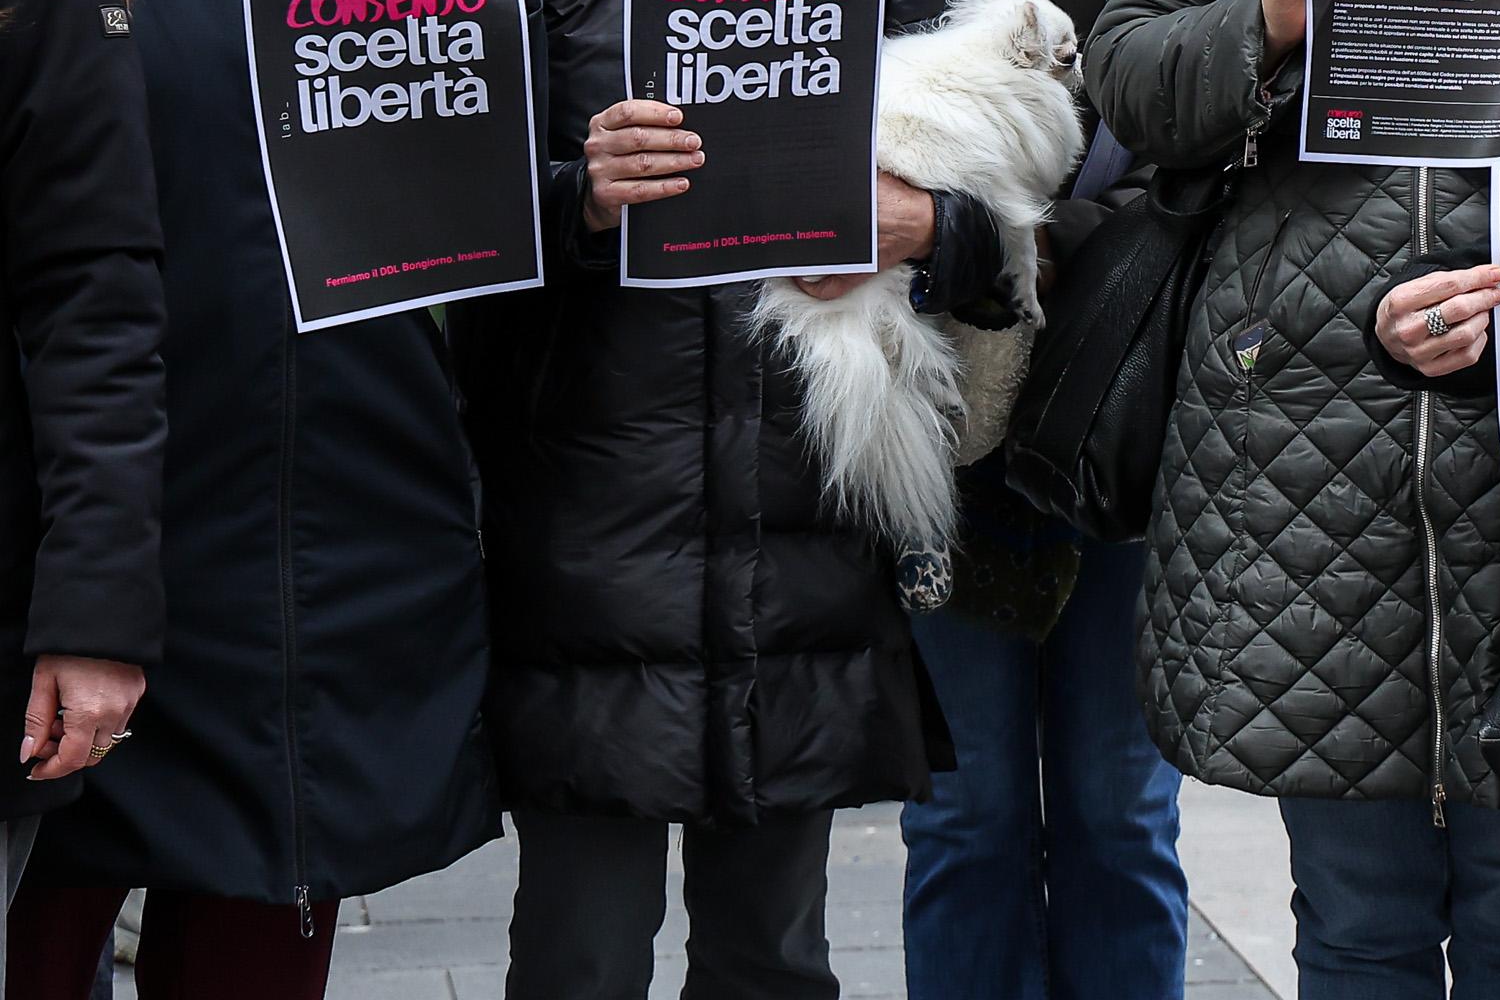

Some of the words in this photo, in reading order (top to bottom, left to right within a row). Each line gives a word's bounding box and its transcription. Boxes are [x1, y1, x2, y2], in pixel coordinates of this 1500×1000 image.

[294, 15, 485, 77] scelta
[665, 47, 841, 105] libertà
[296, 68, 490, 134] libertà
[1326, 127, 1361, 140] libertà
[1327, 117, 1361, 129] scelta
[663, 240, 711, 252] Fermiamo
[712, 238, 719, 247] il
[720, 235, 740, 247] DDL
[742, 232, 793, 244] Bongiorno.
[796, 230, 837, 239] Insieme.
[325, 271, 371, 287] Fermiamo
[371, 268, 378, 277] il
[379, 264, 400, 276] DDL
[401, 255, 458, 272] Bongiorno.
[457, 249, 501, 261] Insieme.
